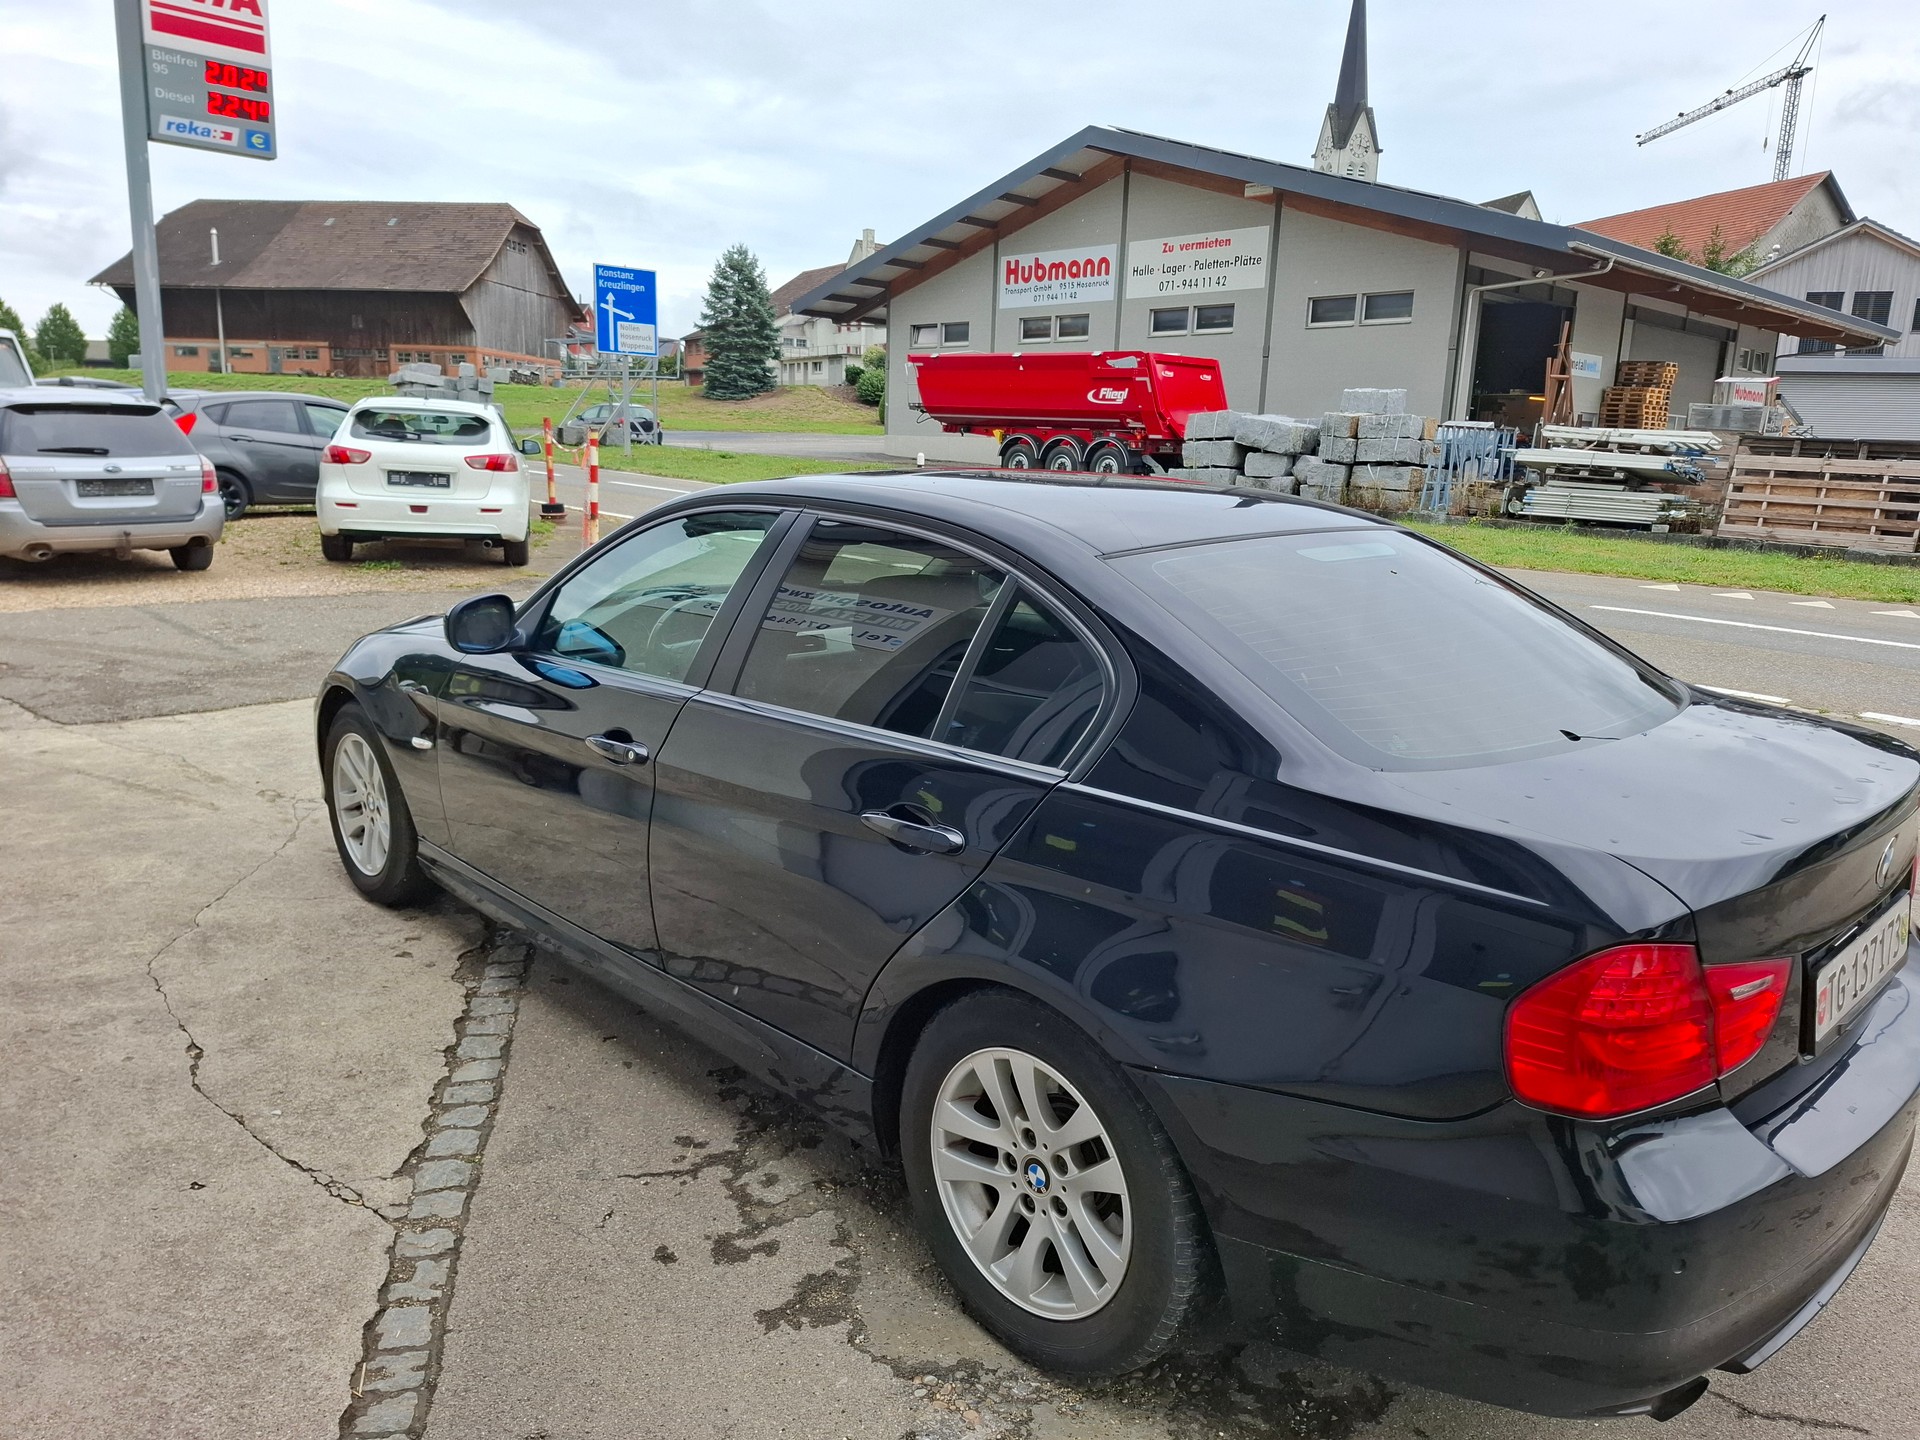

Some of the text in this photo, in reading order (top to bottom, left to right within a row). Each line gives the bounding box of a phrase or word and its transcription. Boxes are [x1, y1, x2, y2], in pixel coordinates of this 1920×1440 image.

[152, 49, 198, 68] Bleifrei
[152, 62, 169, 75] 95
[154, 87, 195, 104] Diesel
[1162, 236, 1232, 254] Zu vermieten
[598, 267, 634, 280] Konstanz
[1005, 256, 1111, 286] Hubmann
[1132, 254, 1262, 277] Halle Lager Paletten-Plätze
[598, 279, 645, 293] Kreuzlingen
[1005, 279, 1110, 296] Transport GmbH 9515 Hosenruck
[1159, 275, 1227, 292] 071-944 11 42
[1033, 294, 1045, 303] 071
[1046, 293, 1058, 301] 944
[1069, 291, 1078, 299] 42
[620, 332, 653, 342] Hosenruck
[1099, 387, 1129, 402] Fliegl
